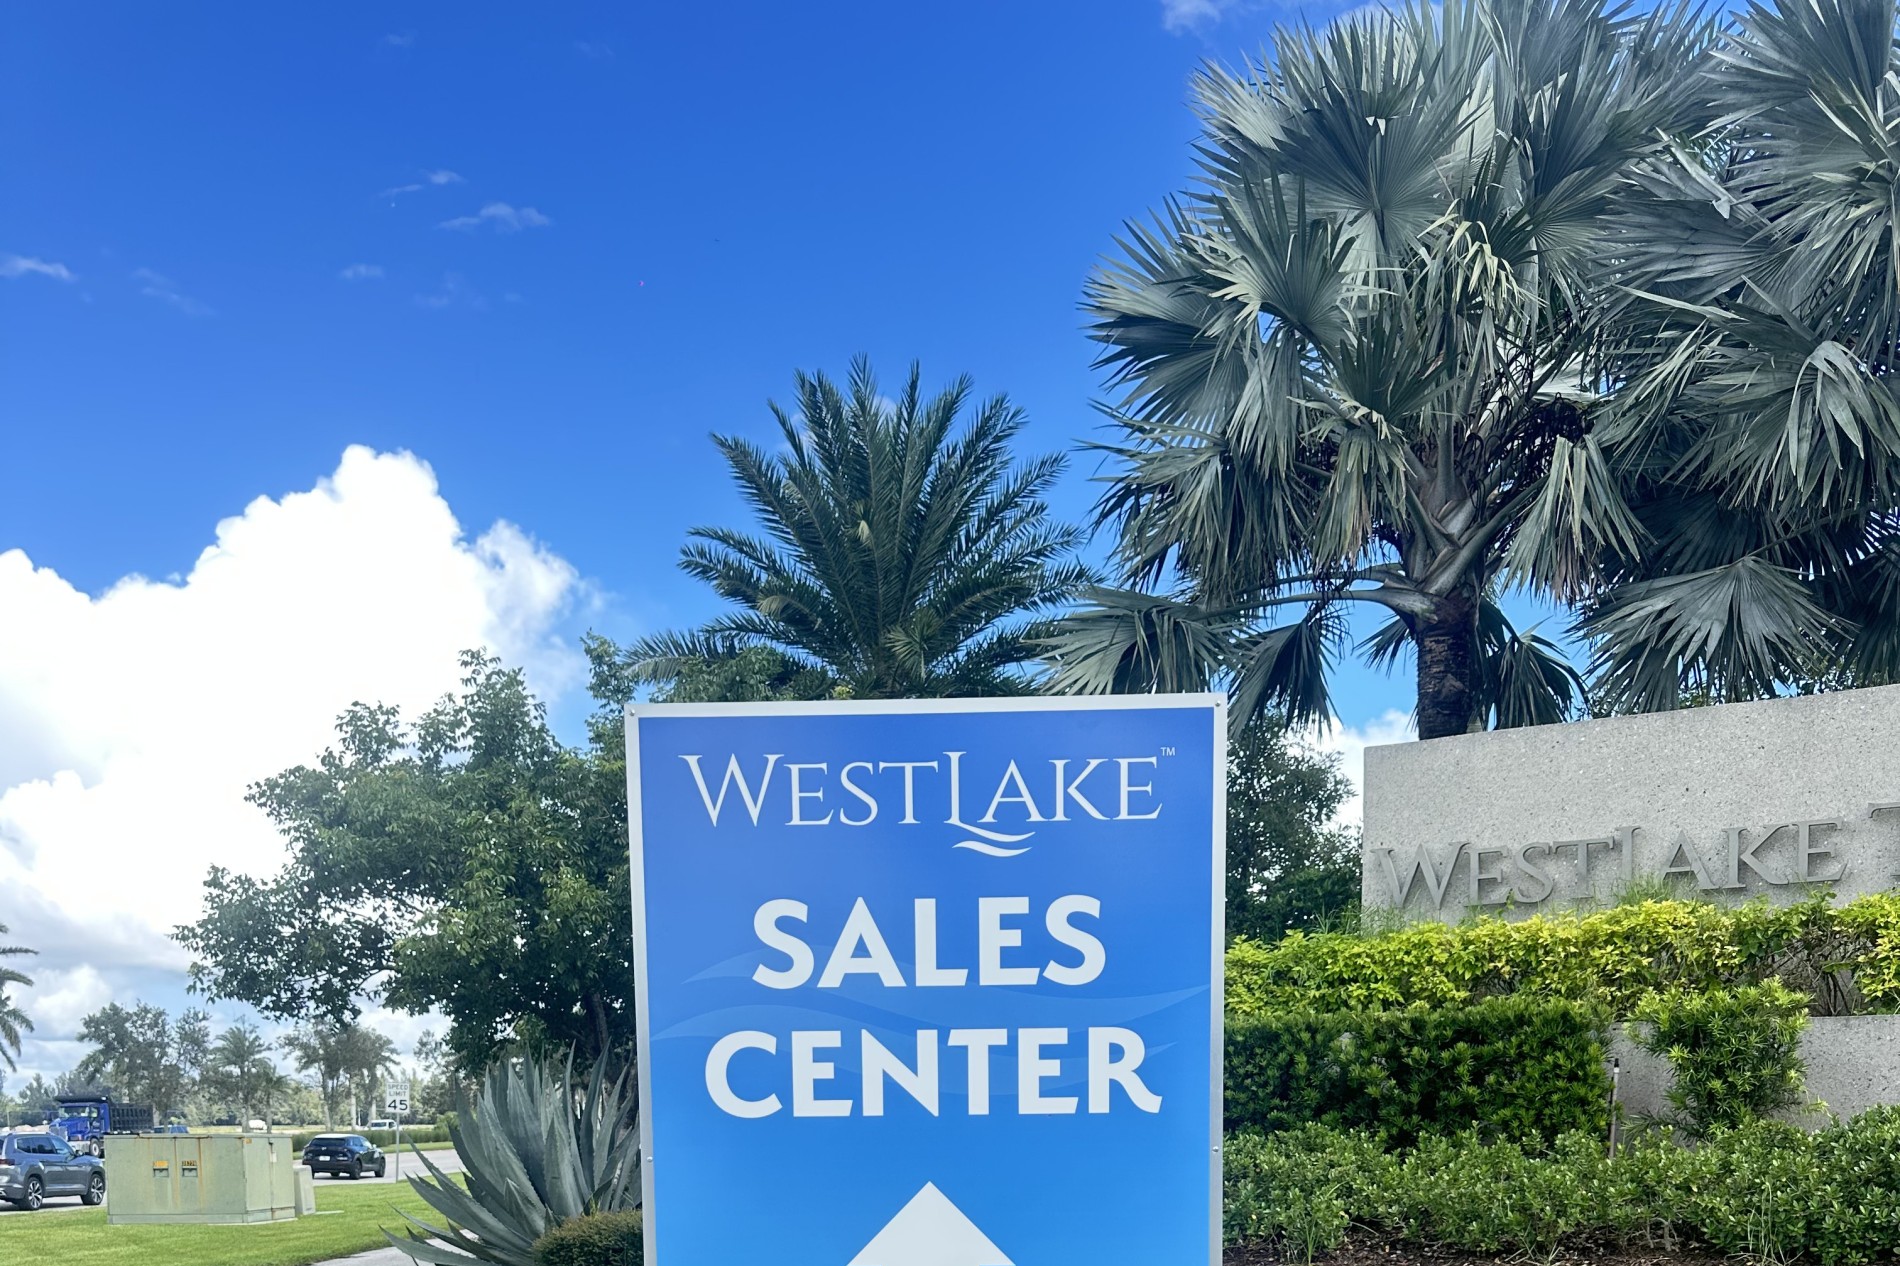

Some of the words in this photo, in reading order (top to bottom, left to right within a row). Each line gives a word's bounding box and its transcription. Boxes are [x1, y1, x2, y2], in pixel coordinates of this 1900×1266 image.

[751, 894, 1106, 990] SALES
[387, 1099, 408, 1111] 45
[704, 1026, 1163, 1119] CENTER
